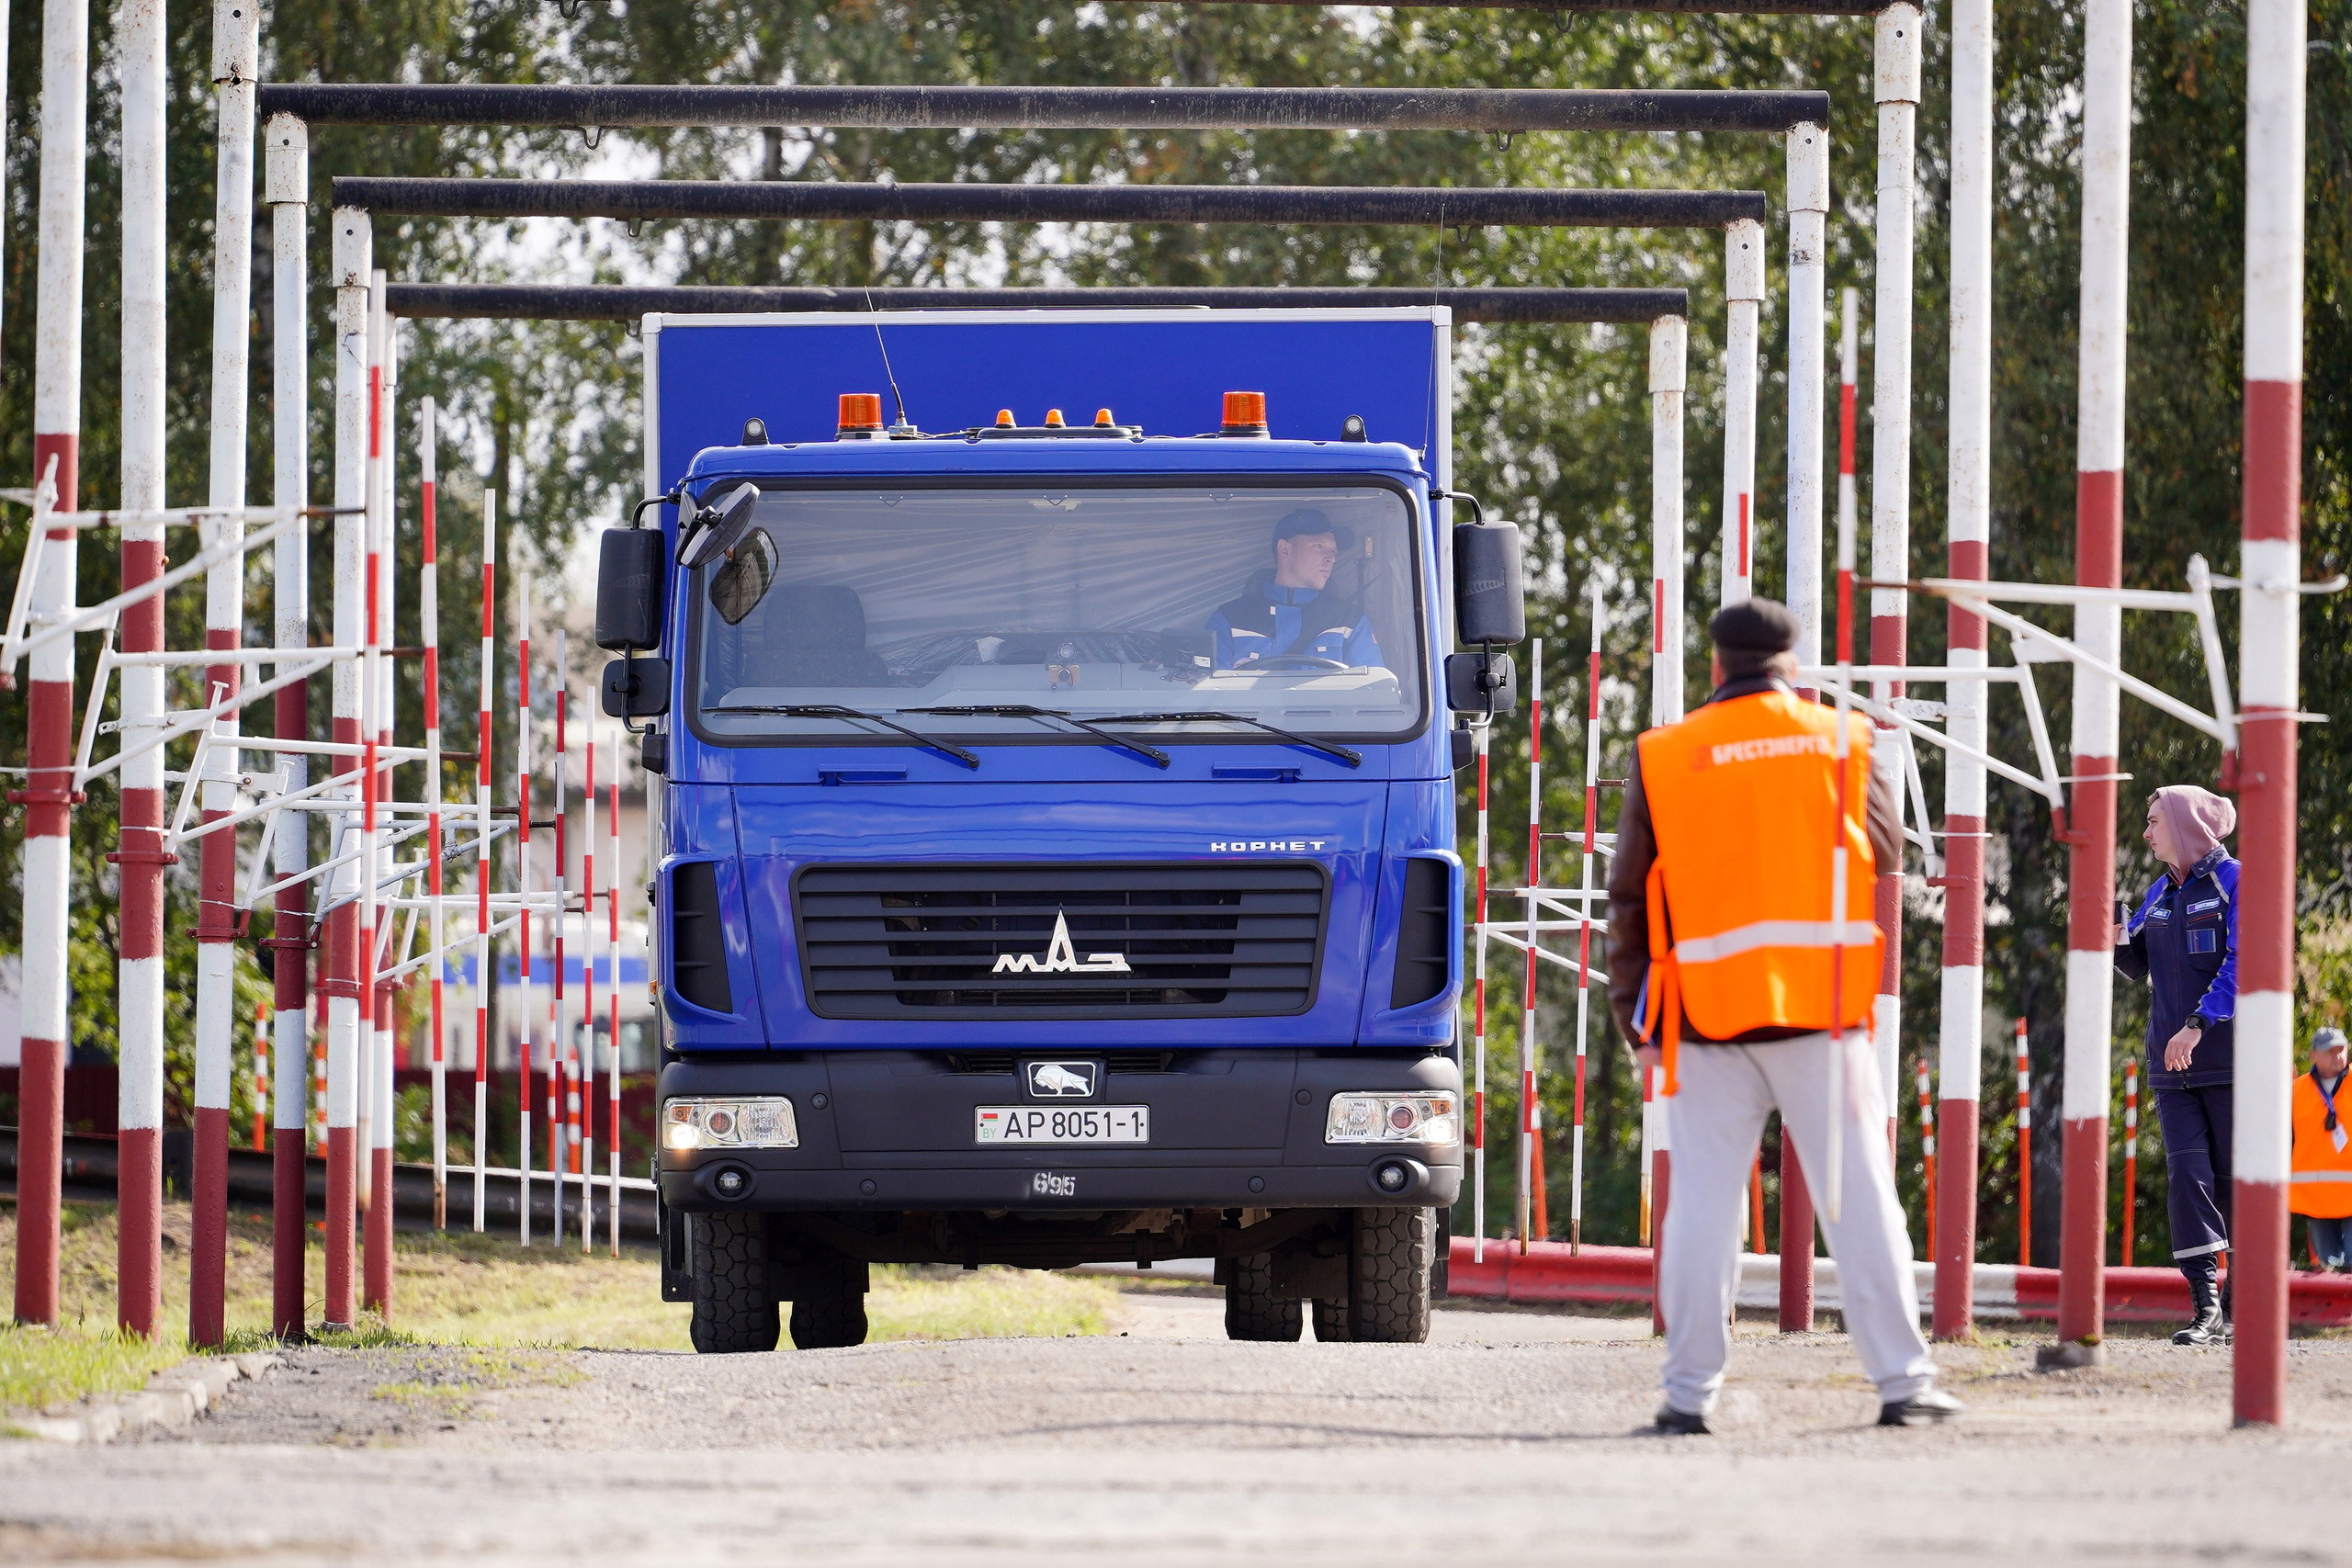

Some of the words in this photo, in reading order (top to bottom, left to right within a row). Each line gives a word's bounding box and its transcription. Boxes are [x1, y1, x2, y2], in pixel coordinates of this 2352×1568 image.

[1210, 840, 1326, 852] КОРНЕТ
[982, 1127, 997, 1139] BY
[1033, 1171, 1076, 1196] 695
